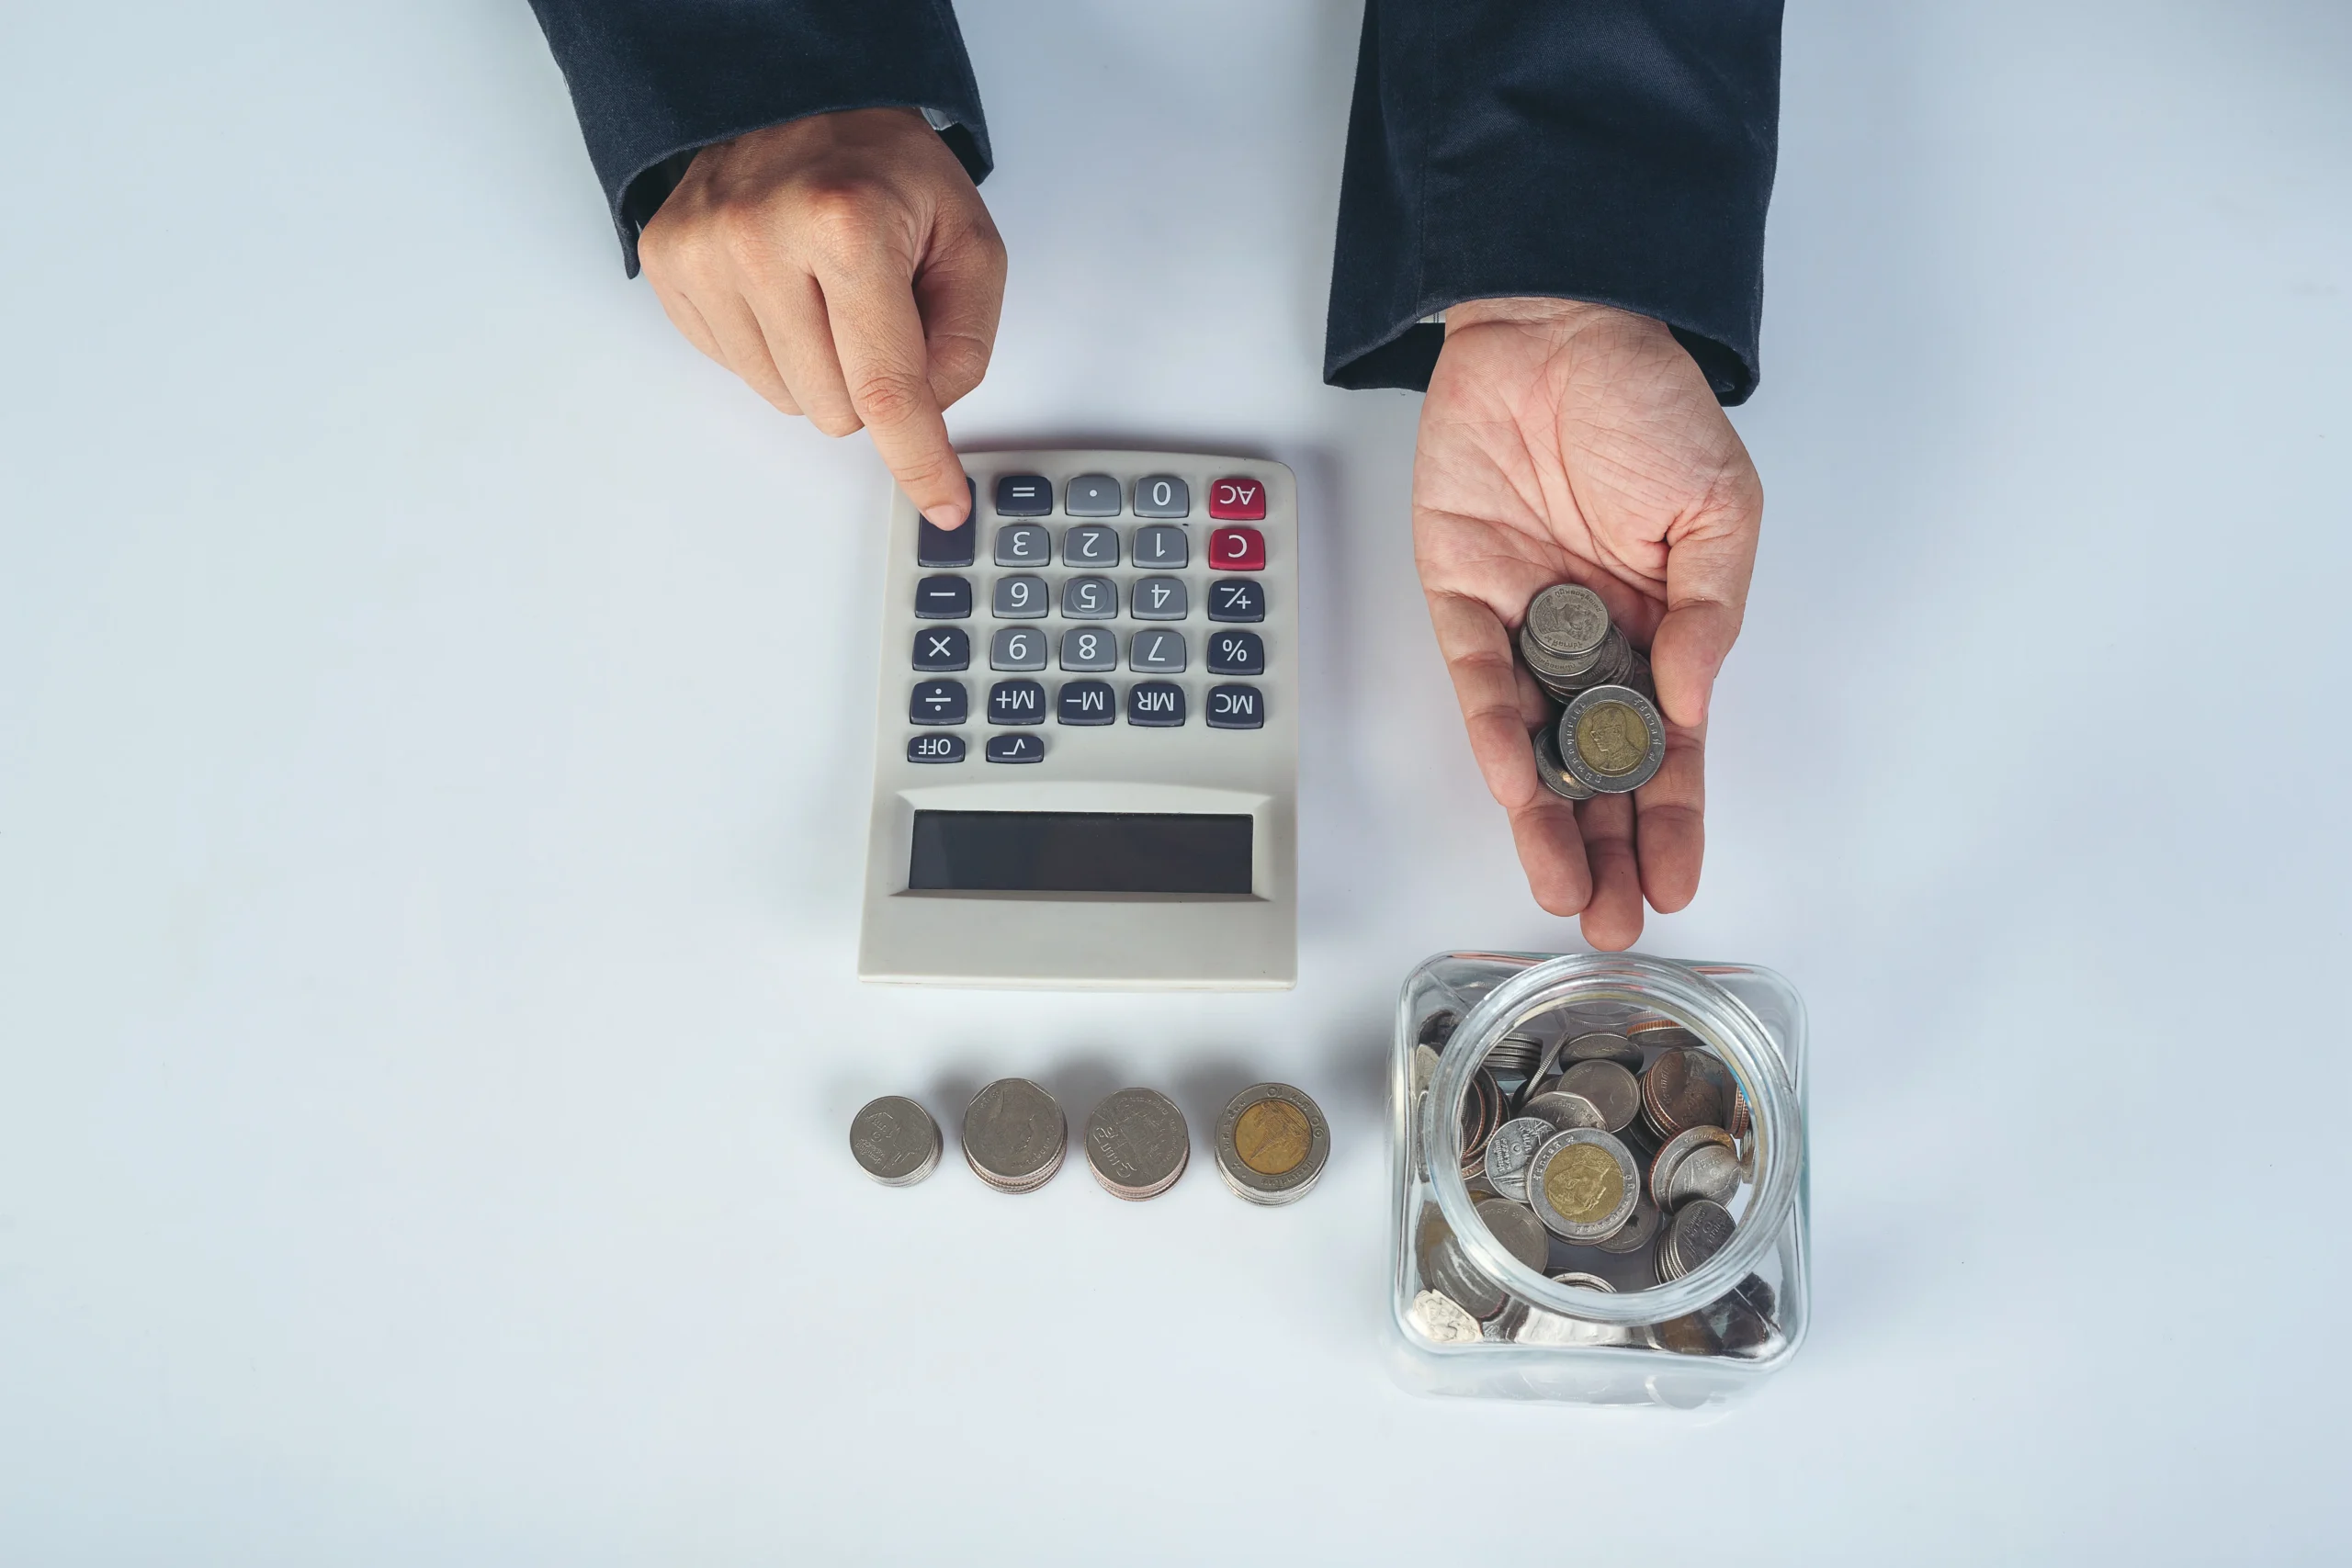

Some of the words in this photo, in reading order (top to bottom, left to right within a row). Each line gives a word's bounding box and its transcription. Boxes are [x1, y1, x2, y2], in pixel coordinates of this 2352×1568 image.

[1152, 481, 1171, 506] 0
[1219, 484, 1257, 506] AC
[1012, 531, 1031, 556] 3
[1082, 532, 1100, 558] 2
[1156, 532, 1166, 558] 1
[1227, 534, 1248, 558] C
[1011, 581, 1029, 608] 6
[1080, 583, 1097, 609] 5
[1150, 583, 1171, 609] 4
[1009, 634, 1027, 660] 9
[1079, 634, 1097, 660] 8
[1148, 636, 1166, 662] 7
[1222, 638, 1248, 662] %
[995, 690, 1035, 710] M+
[1136, 691, 1174, 712] MR
[1215, 693, 1253, 715] MC
[917, 738, 952, 756] OFF
